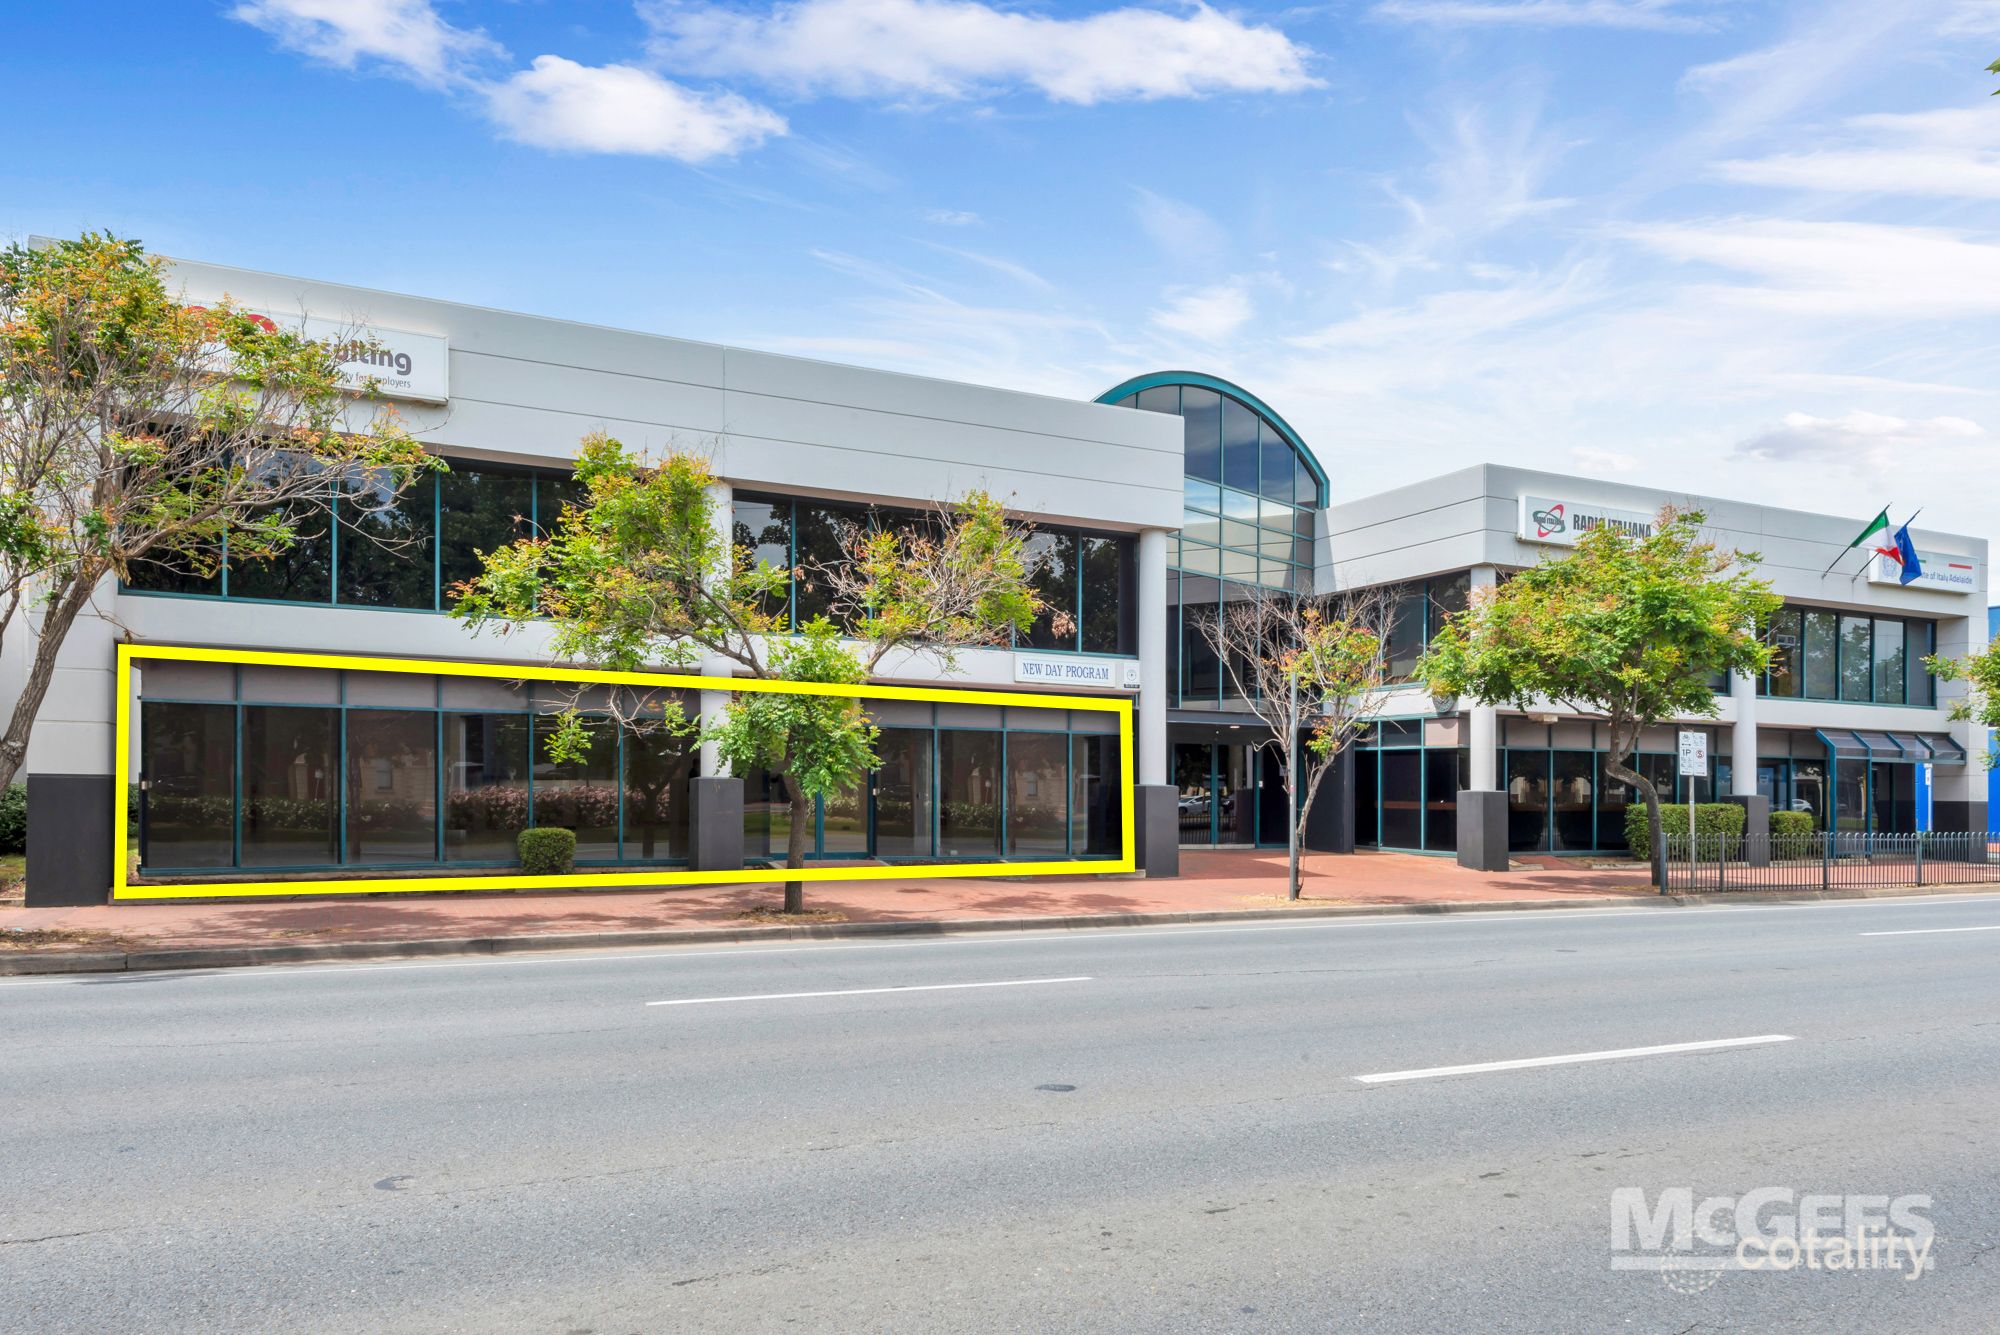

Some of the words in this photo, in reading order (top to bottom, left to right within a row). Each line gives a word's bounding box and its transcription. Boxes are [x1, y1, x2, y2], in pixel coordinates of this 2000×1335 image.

[1608, 518, 1651, 538] ITALIANA
[1937, 572, 1949, 582] Italy
[1949, 573, 1973, 585] Adelaide
[1022, 662, 1043, 675] NEW
[1045, 664, 1063, 677] DAY
[1066, 665, 1109, 680] PROGRAM
